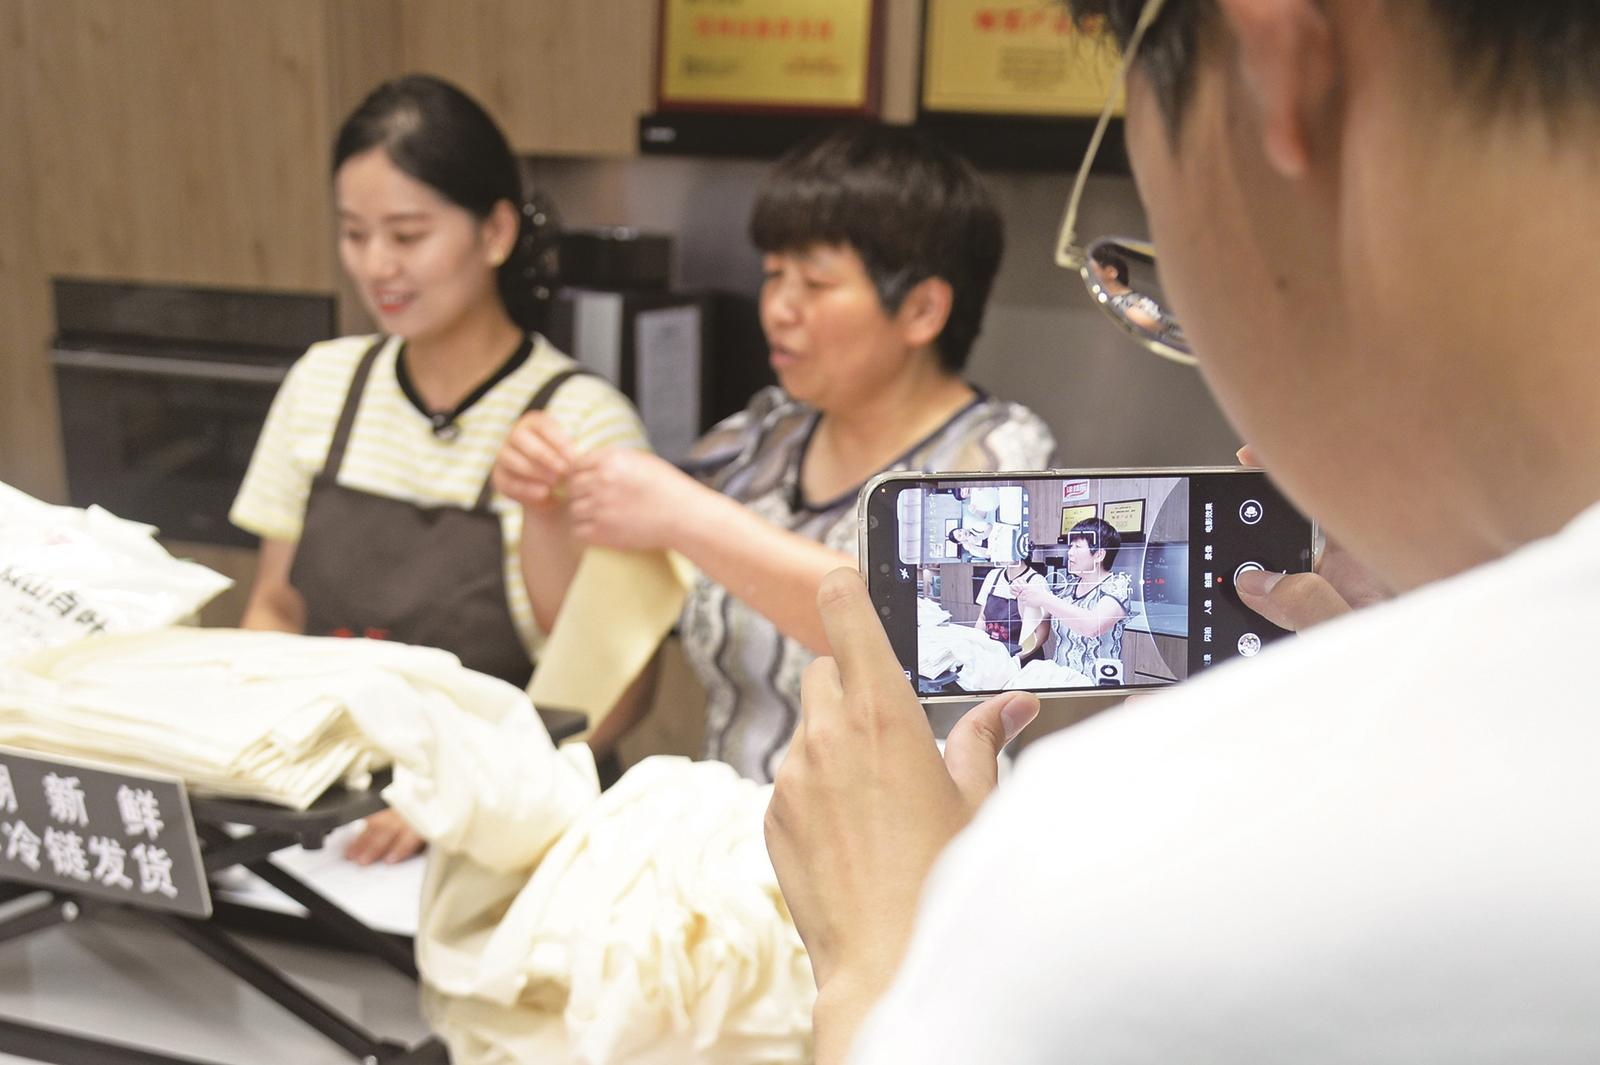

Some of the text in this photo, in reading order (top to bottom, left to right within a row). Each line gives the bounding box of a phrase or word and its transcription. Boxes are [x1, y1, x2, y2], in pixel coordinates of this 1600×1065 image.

[1203, 599, 1213, 615] 人像
[0, 818, 178, 898] 冷链发货
